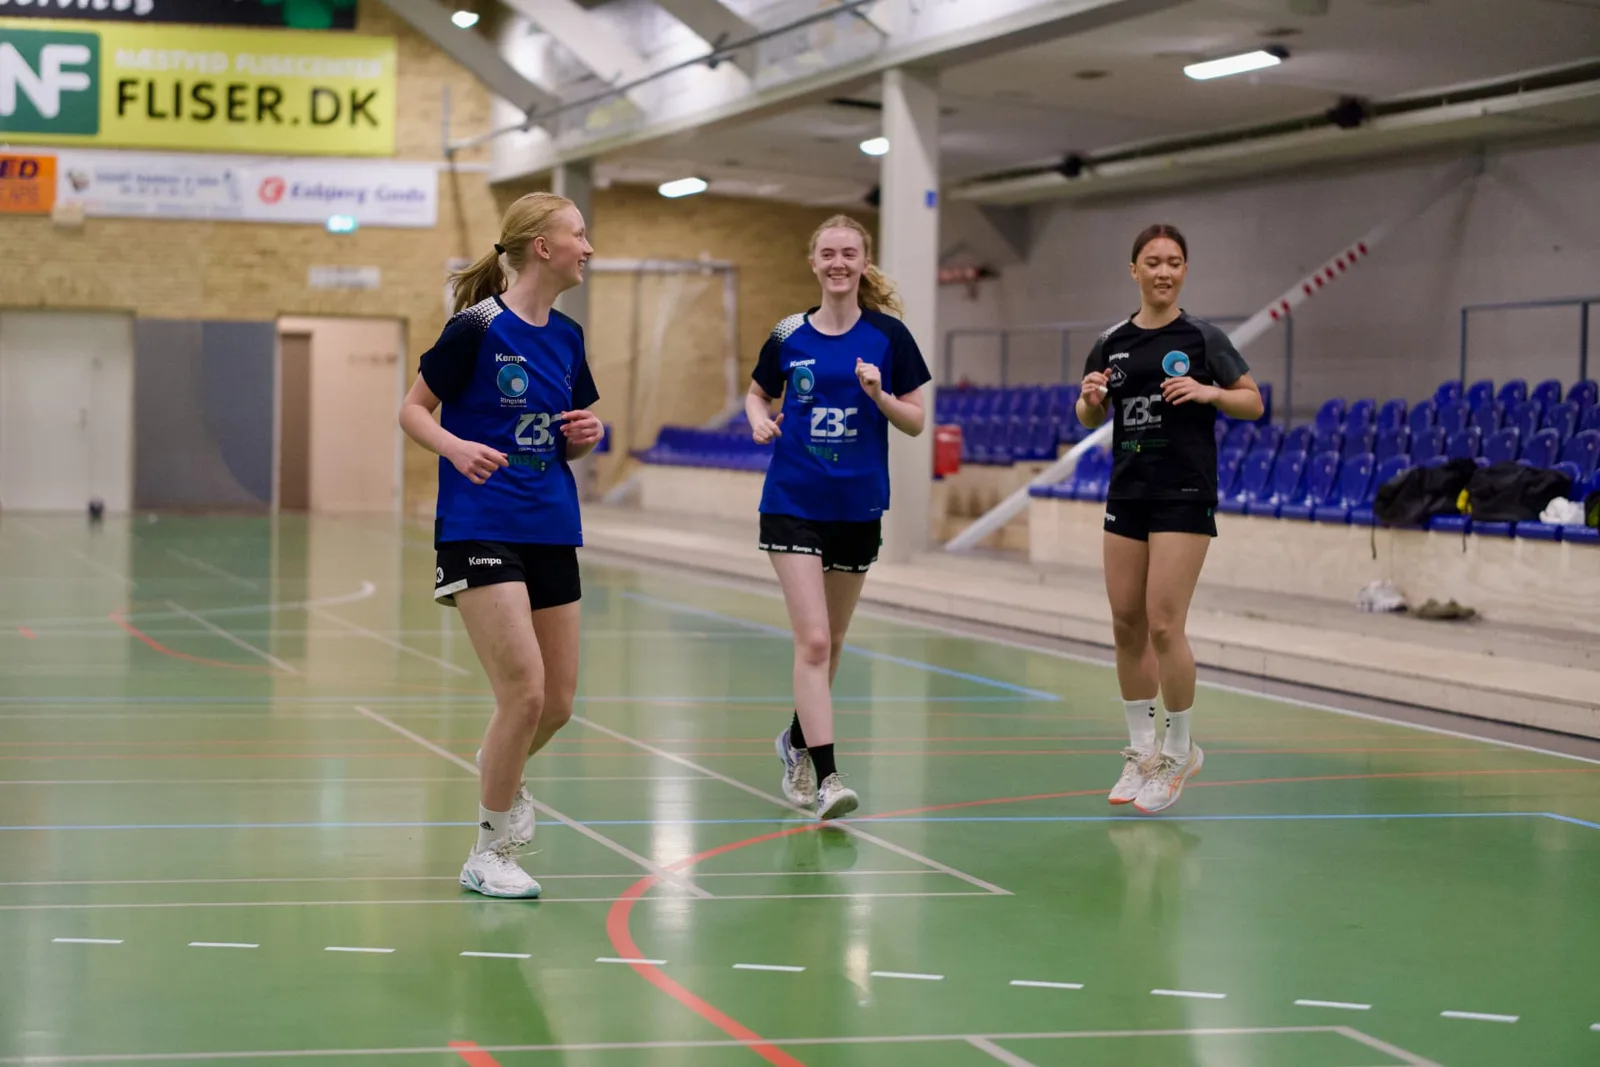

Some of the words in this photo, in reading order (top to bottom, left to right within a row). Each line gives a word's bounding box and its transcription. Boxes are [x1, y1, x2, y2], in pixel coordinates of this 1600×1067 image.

[117, 78, 379, 127] FLISER.DK
[790, 359, 816, 368] Kempa
[810, 407, 858, 437] ZBC
[1121, 394, 1162, 426] ZBC
[468, 556, 502, 566] Kempa
